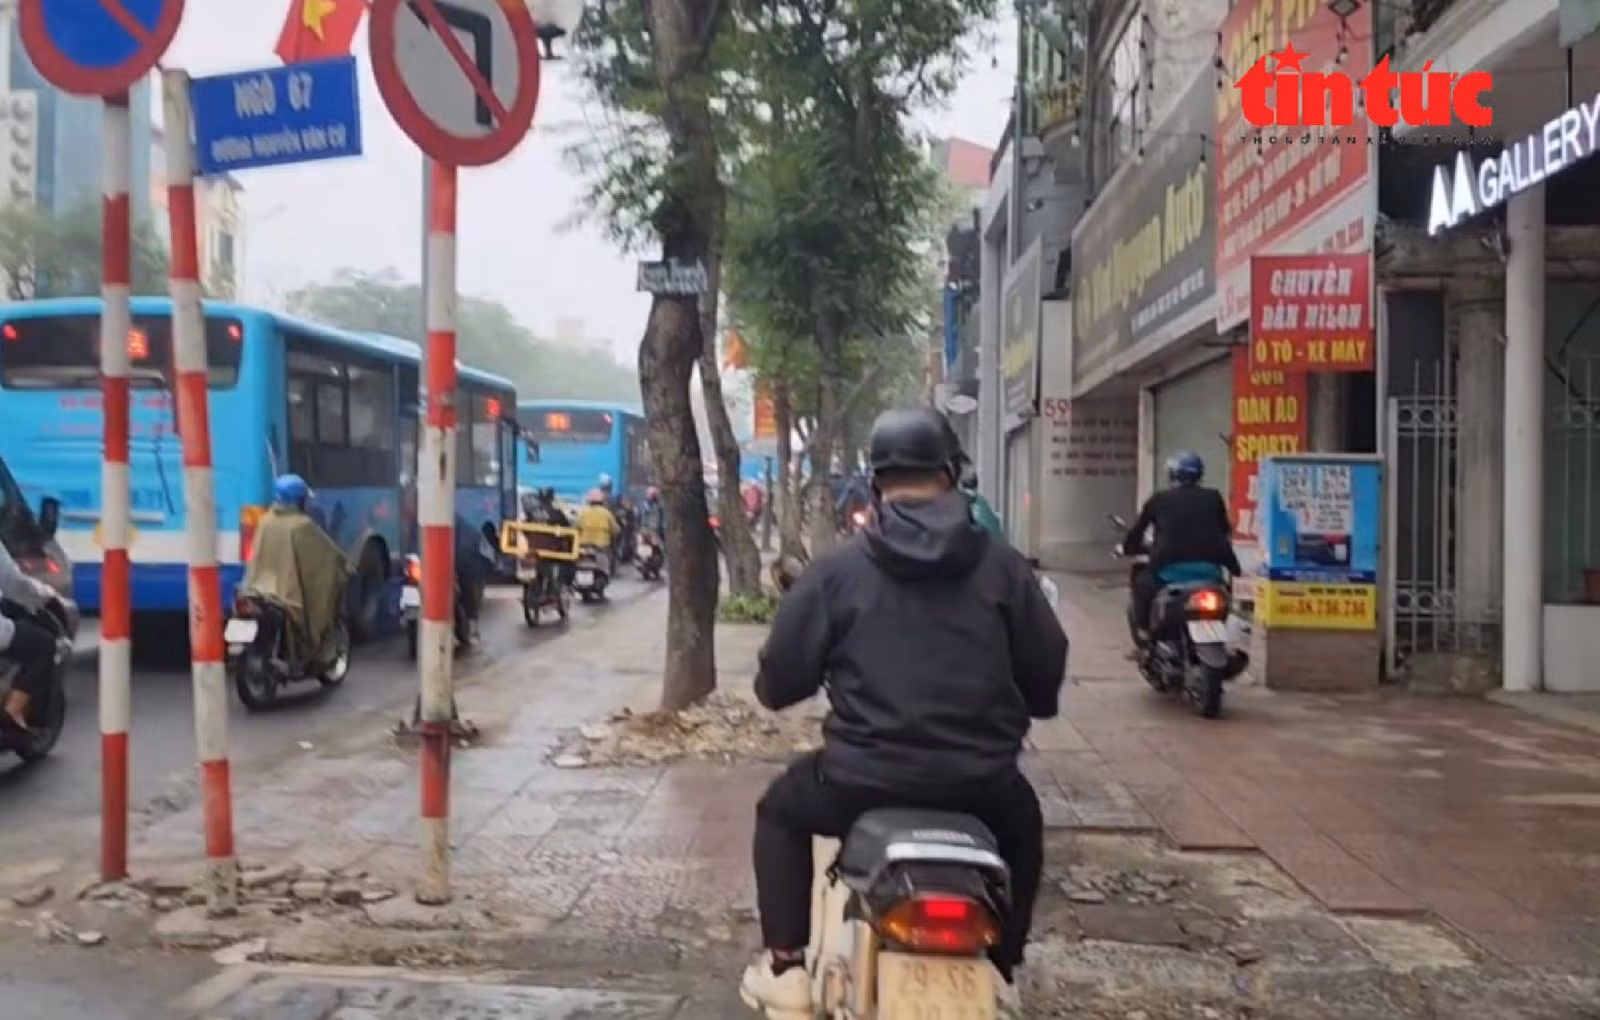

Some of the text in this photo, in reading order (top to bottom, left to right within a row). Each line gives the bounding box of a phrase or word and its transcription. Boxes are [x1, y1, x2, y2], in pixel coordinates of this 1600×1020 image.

[287, 71, 313, 112] 67
[1478, 92, 1600, 208] GALLERY
[1269, 261, 1354, 297] CHUYÊN
[1307, 339, 1327, 363] XE
